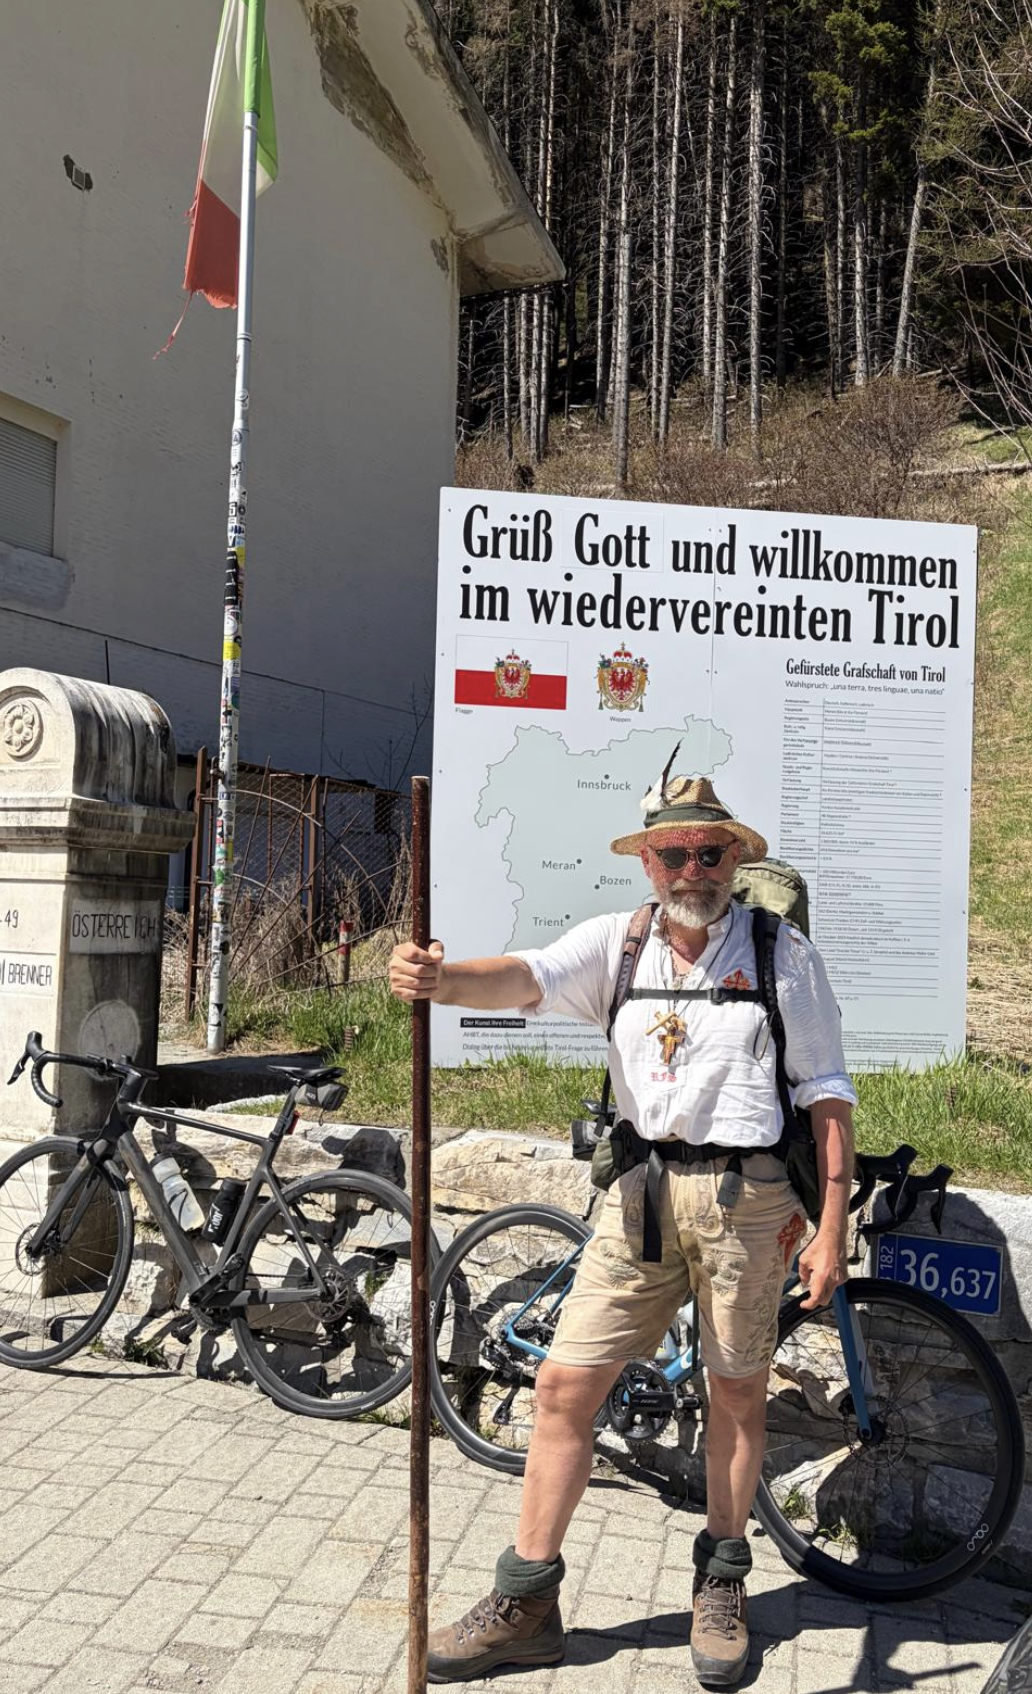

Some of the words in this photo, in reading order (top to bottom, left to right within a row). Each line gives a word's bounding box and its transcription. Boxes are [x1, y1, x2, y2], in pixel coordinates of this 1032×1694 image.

[463, 504, 553, 562] Grüß
[575, 513, 651, 569] Gott
[671, 524, 737, 575] und
[749, 529, 958, 589] willkommen
[459, 565, 510, 622] im
[527, 572, 852, 643] wiedervereinten
[868, 588, 959, 648] Tirol
[786, 658, 840, 677] Gefürstete
[843, 661, 897, 680] Grafschaft
[900, 669, 918, 681] von
[921, 665, 946, 683] Tirol
[785, 680, 829, 690] Wahlspruch:
[868, 685, 882, 693] tres
[577, 779, 632, 791] Innsbruck
[541, 860, 576, 871] Meran
[600, 875, 632, 886] Bozen
[72, 909, 156, 939] ÖSTERREICH
[532, 916, 564, 927] Trient
[880, 1245, 894, 1270] 182
[900, 1249, 997, 1300] 36,637
